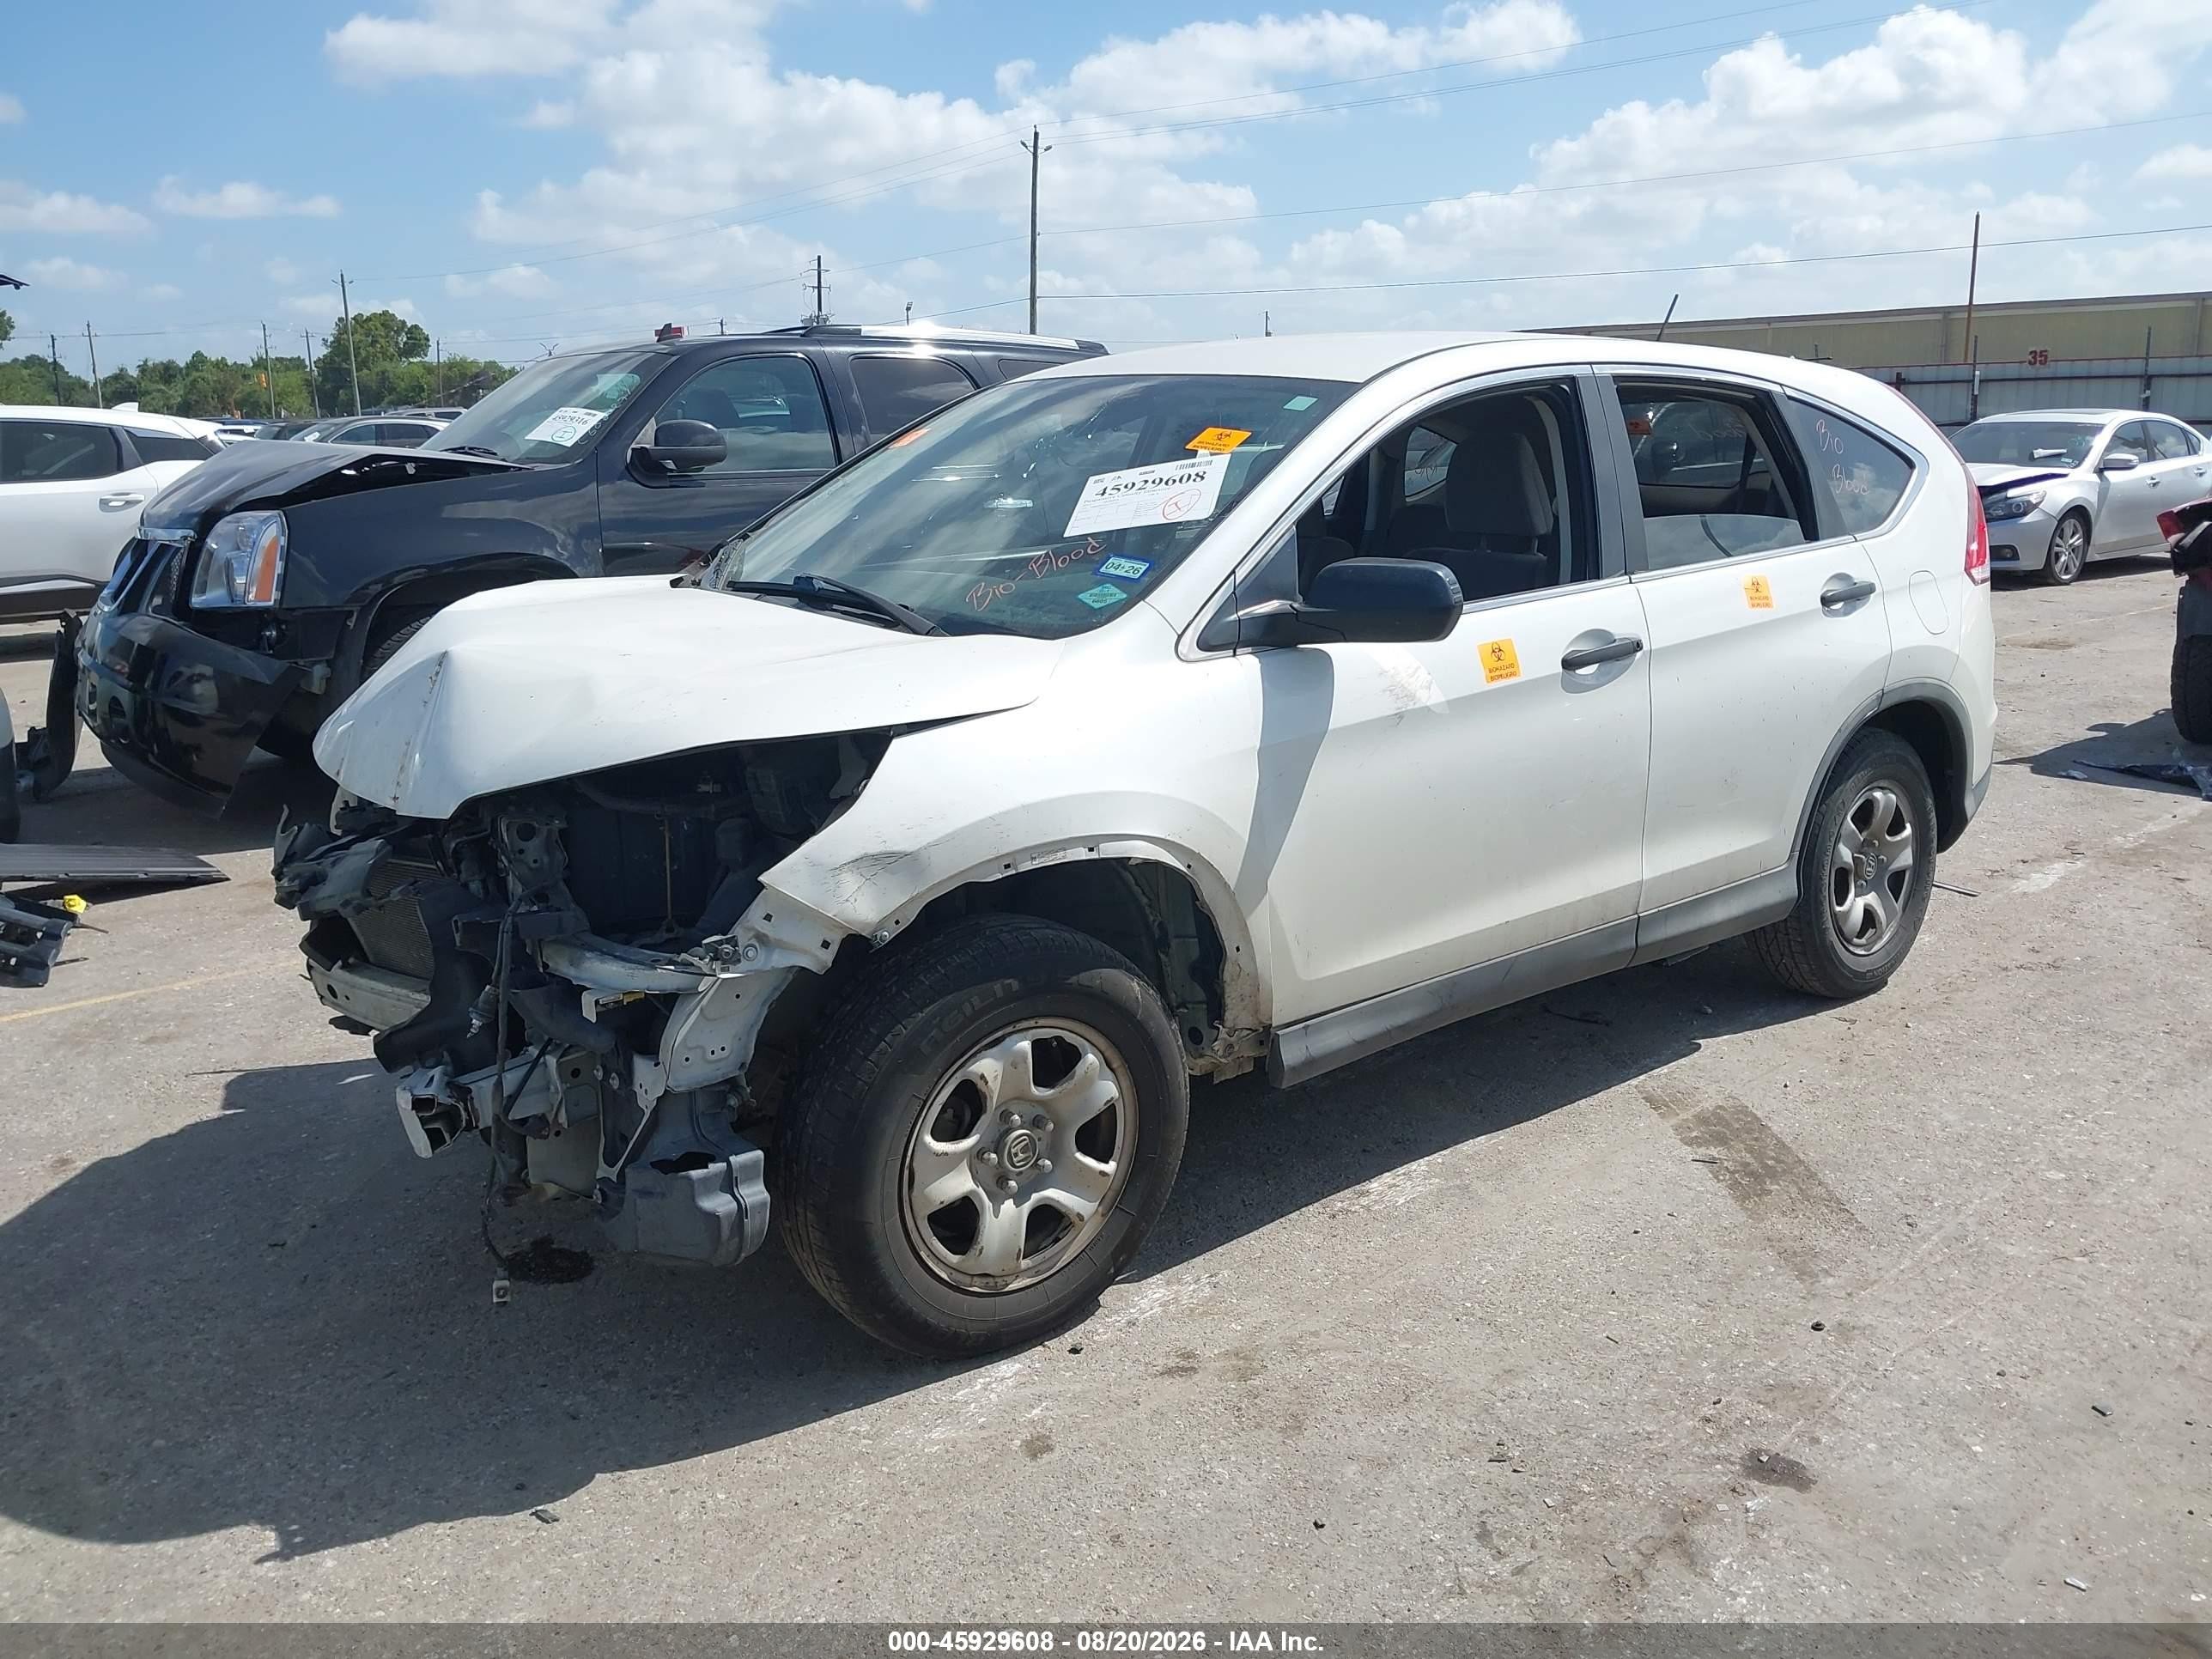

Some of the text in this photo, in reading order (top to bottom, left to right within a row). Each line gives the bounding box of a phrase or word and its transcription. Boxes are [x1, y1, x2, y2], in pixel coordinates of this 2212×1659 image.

[2028, 349, 2048, 365] 35
[1815, 419, 1844, 454] Bio
[1094, 470, 1207, 497] 45929608
[1124, 565, 1143, 575] 26
